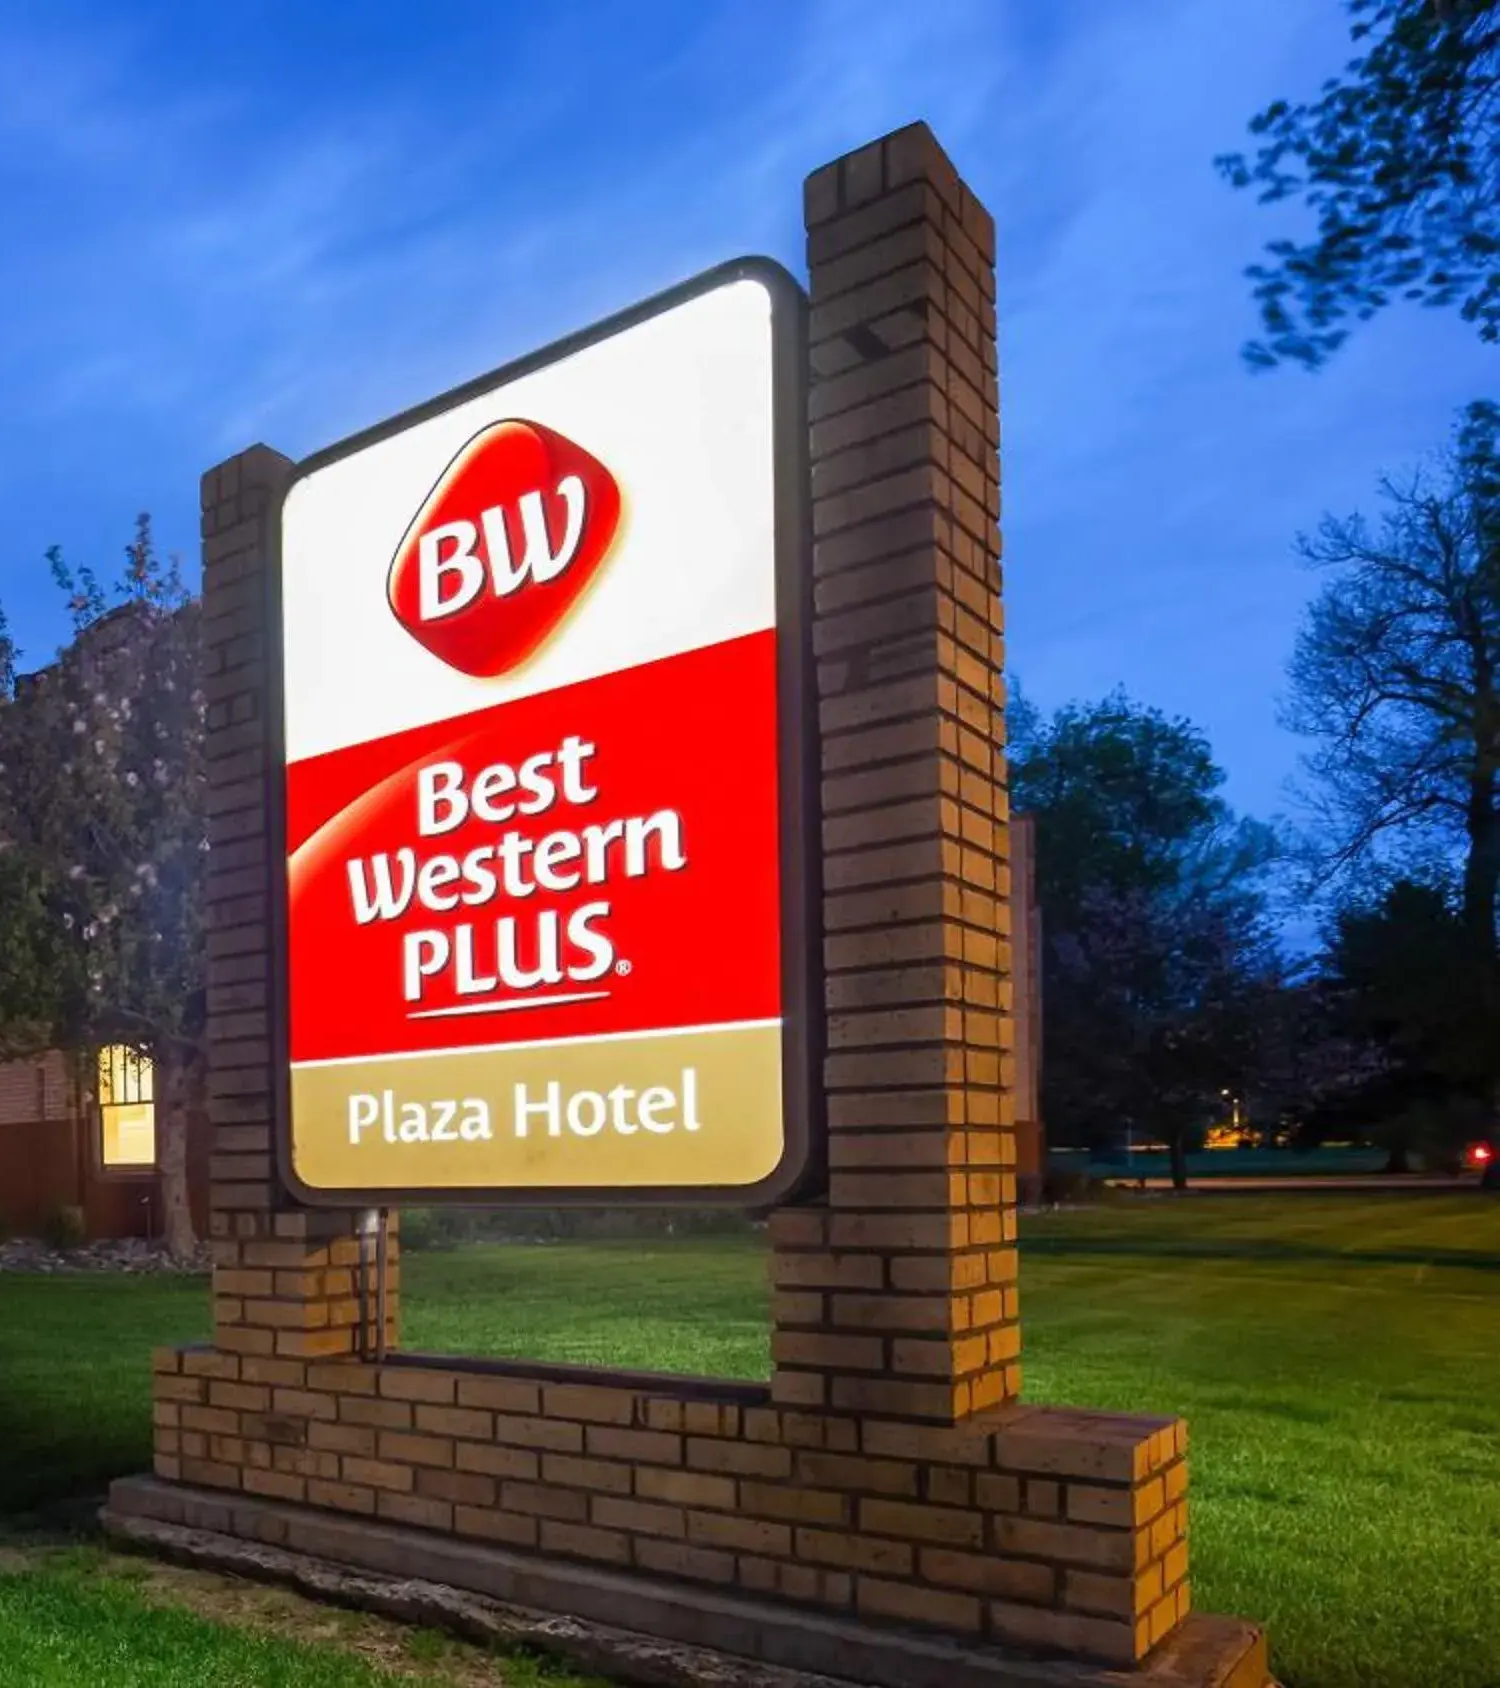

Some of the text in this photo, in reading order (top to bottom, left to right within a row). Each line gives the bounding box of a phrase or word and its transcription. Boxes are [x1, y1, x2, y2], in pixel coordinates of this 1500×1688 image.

[418, 474, 587, 622] BW
[417, 735, 598, 836] Best
[346, 808, 687, 925] Western
[403, 900, 615, 1001] PLUS
[346, 1066, 701, 1146] Plaza Hotel
